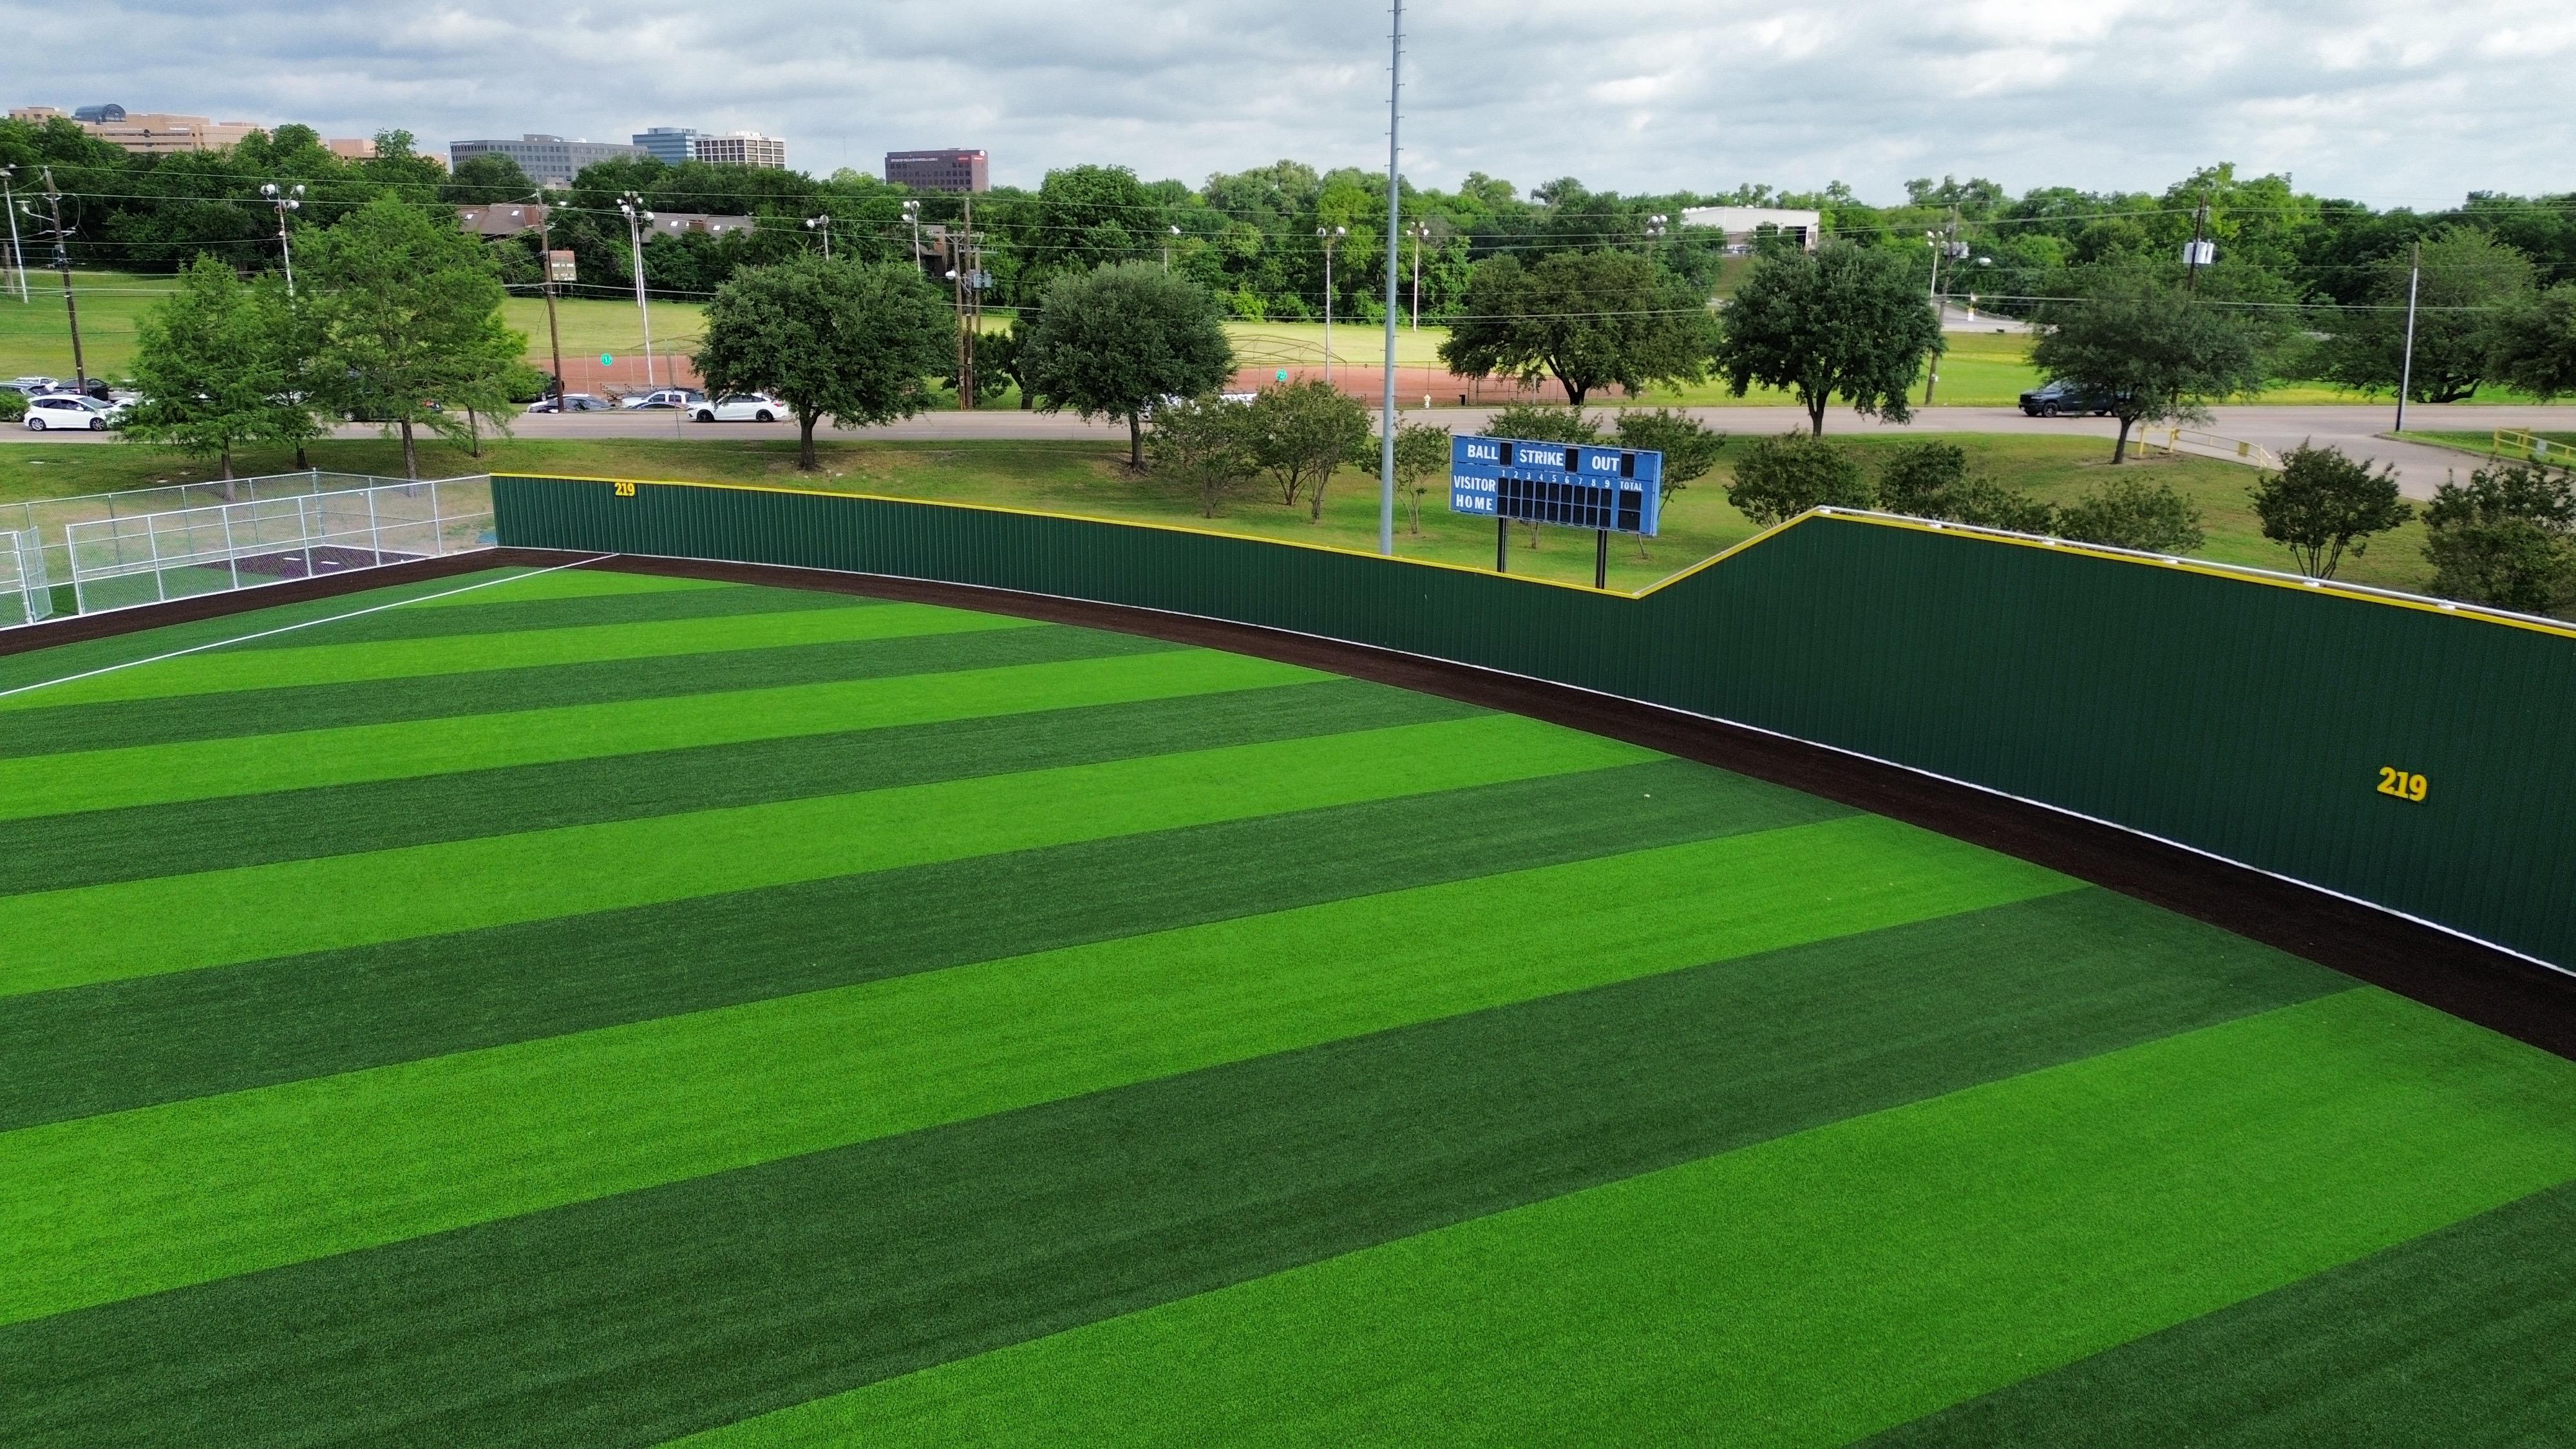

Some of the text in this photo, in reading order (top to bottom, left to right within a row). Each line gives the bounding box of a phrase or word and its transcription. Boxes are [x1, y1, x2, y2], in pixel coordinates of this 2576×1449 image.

[1467, 444, 1620, 471] BALL STRIKE OUT
[614, 482, 635, 496] 219
[1454, 475, 1496, 492] VISITOR
[1578, 477, 1583, 485] 7
[1591, 478, 1596, 487] 8
[1604, 480, 1610, 488] 9
[1620, 481, 1643, 491] TOTAL
[1456, 493, 1493, 511] HOME
[2376, 766, 2427, 801] 219
